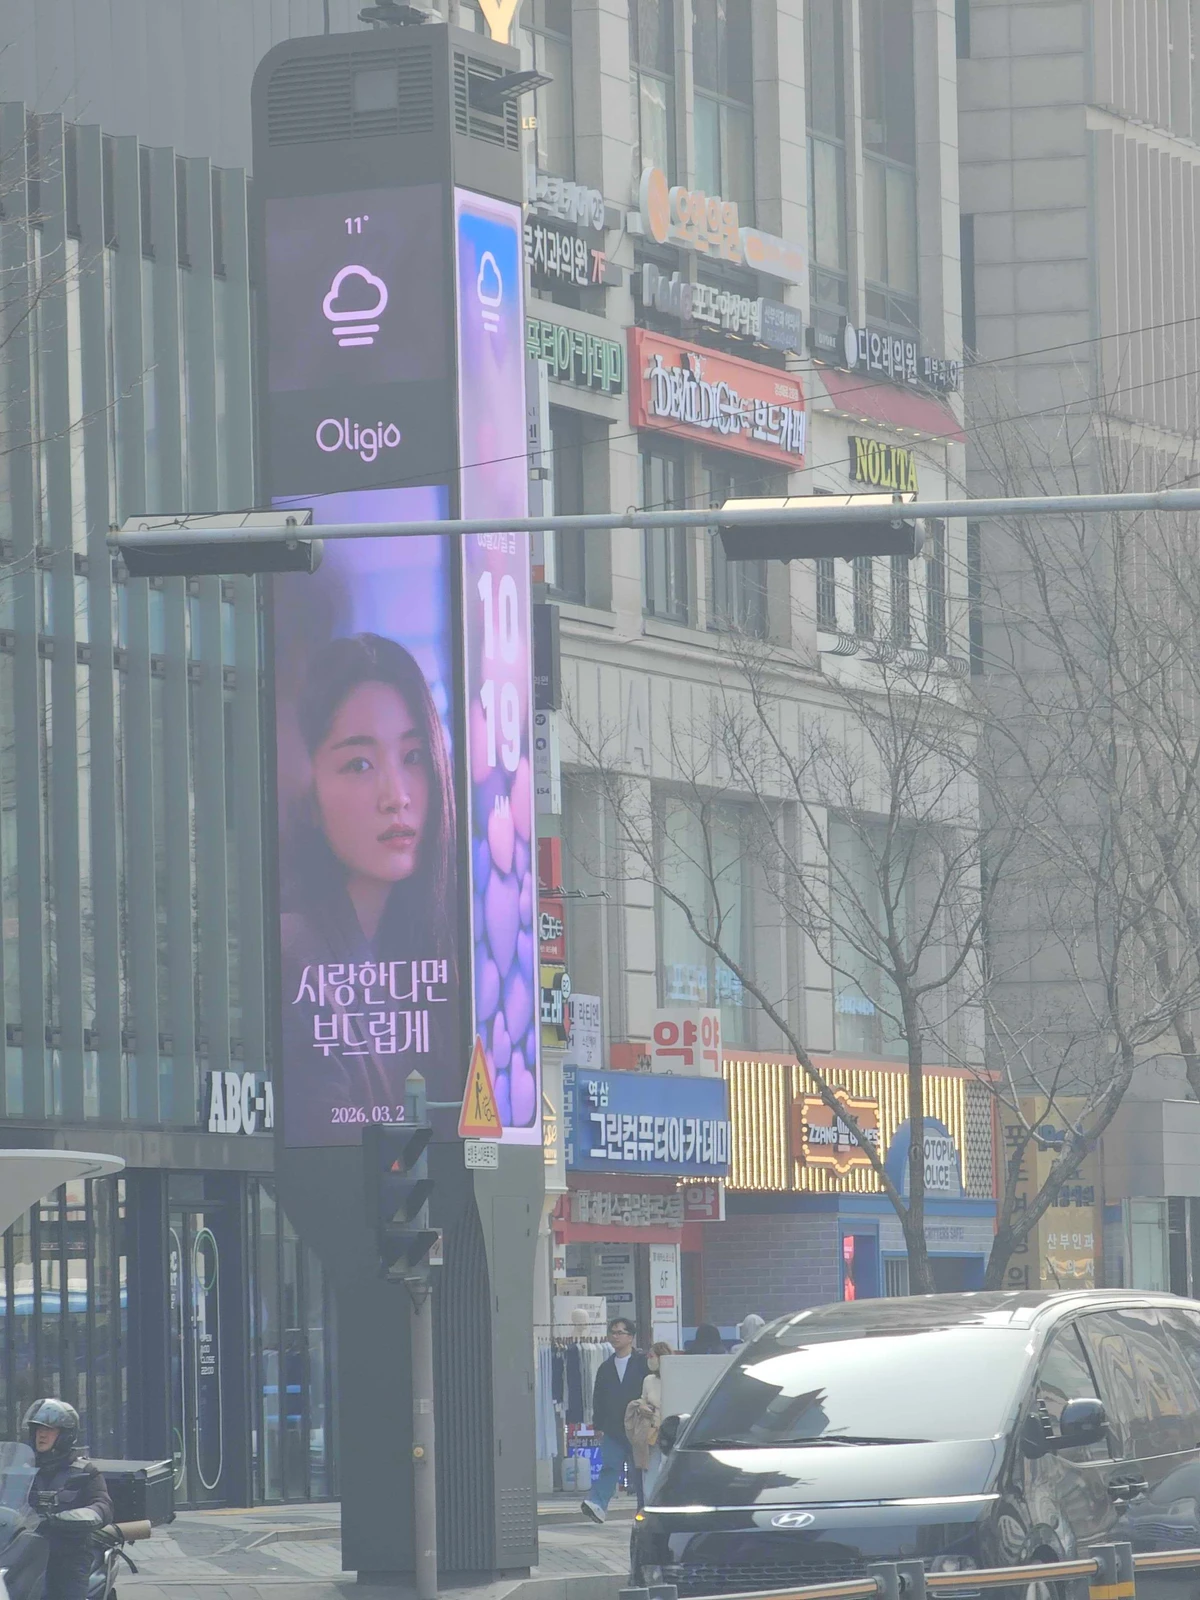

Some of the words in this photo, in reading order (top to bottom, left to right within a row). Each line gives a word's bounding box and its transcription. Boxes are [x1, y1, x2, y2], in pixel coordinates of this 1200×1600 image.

[344, 215, 369, 235] 11°
[858, 329, 917, 385] 디오레의원
[316, 417, 401, 462] Oligio
[855, 437, 919, 491] NOLITA
[477, 571, 519, 664] 10
[479, 679, 521, 772] 19
[494, 795, 510, 819] AM
[291, 959, 448, 1007] 사랑한다면
[312, 1010, 429, 1057] 부드럽게
[653, 1019, 698, 1065] 약
[701, 1016, 719, 1072] 약
[588, 1081, 610, 1107] 역삼
[589, 1112, 732, 1165] 그린컴퓨터아카데미
[808, 1123, 838, 1145] ZZANG
[924, 1138, 955, 1162] OTOPIA
[925, 1164, 949, 1187] OLICE
[1047, 1232, 1094, 1251] 산부인과
